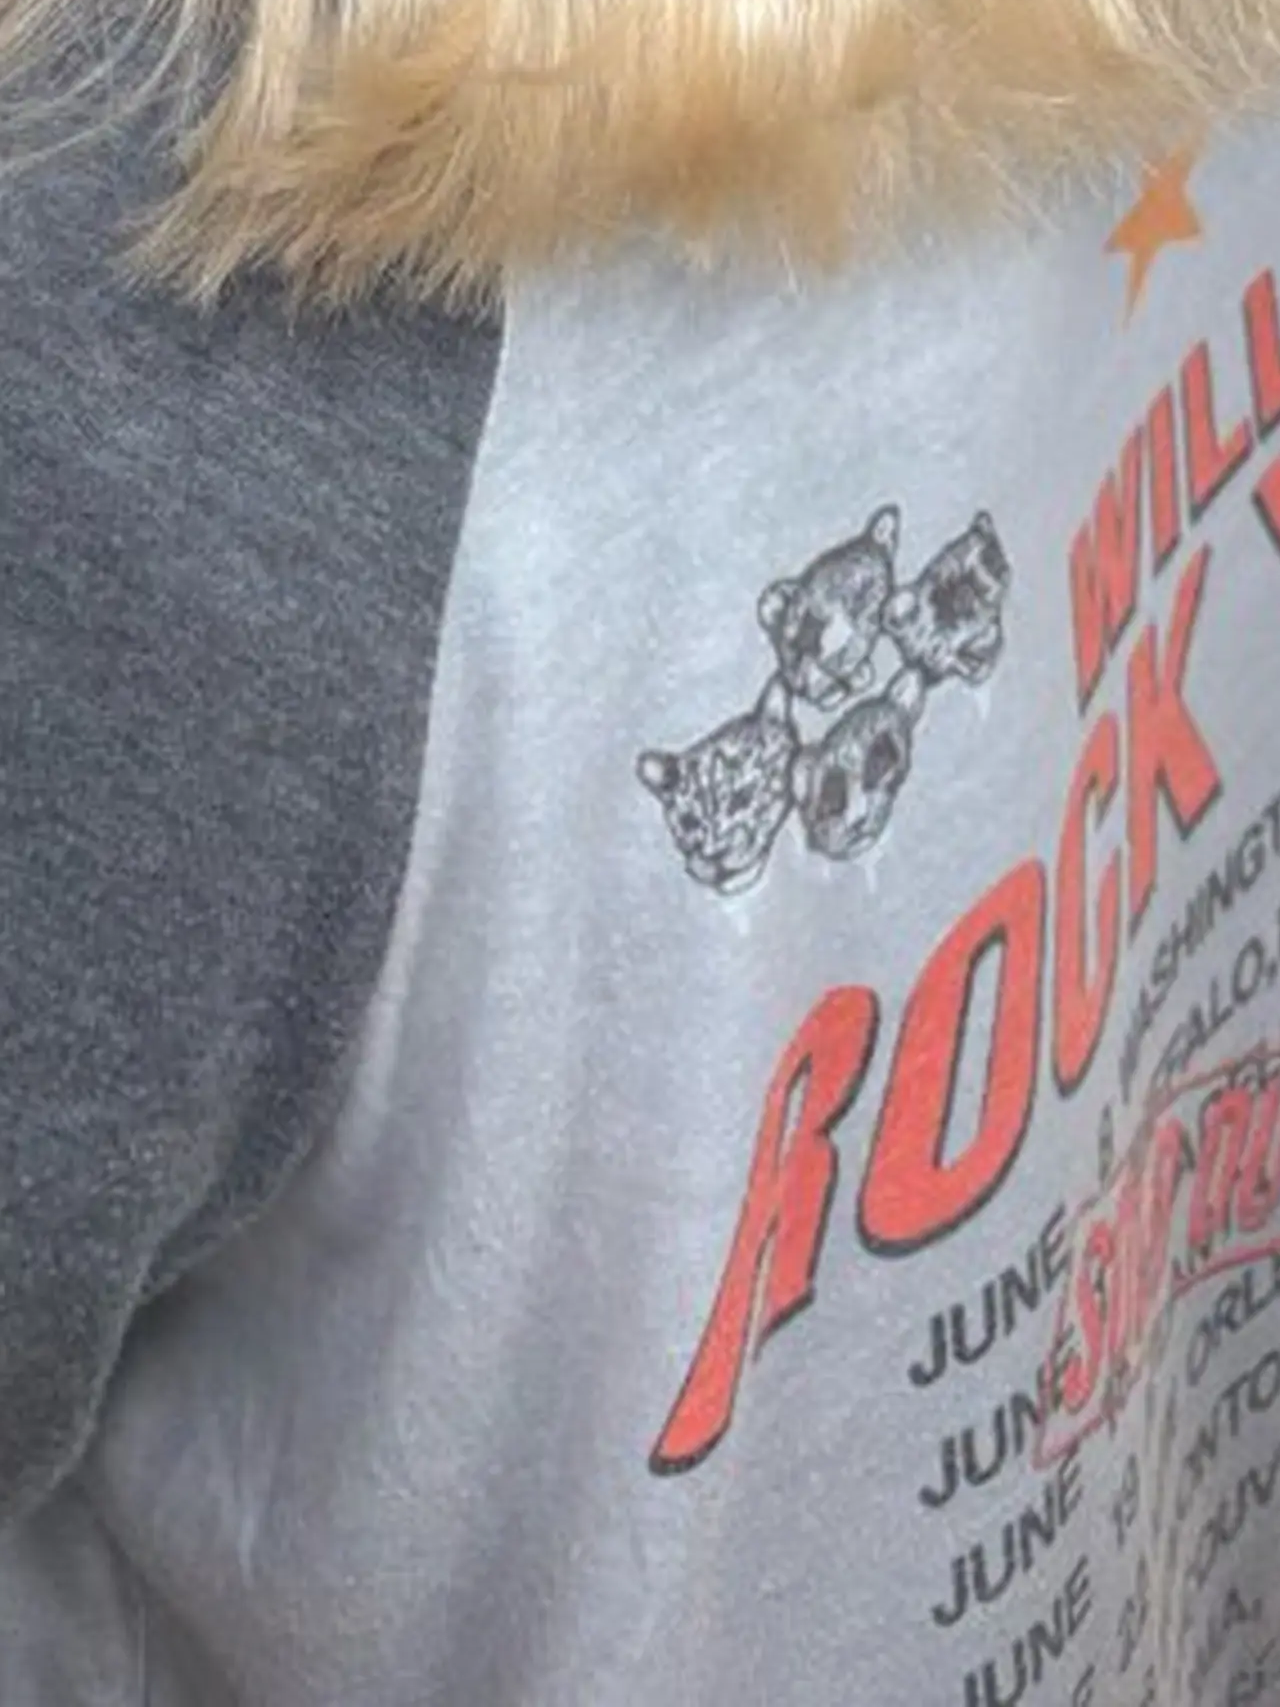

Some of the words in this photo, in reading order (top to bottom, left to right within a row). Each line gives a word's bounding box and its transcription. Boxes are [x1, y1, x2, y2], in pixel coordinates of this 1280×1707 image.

[650, 544, 1224, 1477] ROCK
[907, 1203, 1070, 1389] JUNE
[918, 1325, 1076, 1509] JUNE
[931, 1453, 1083, 1628] JUNE
[958, 1554, 1093, 1707] JUNE
